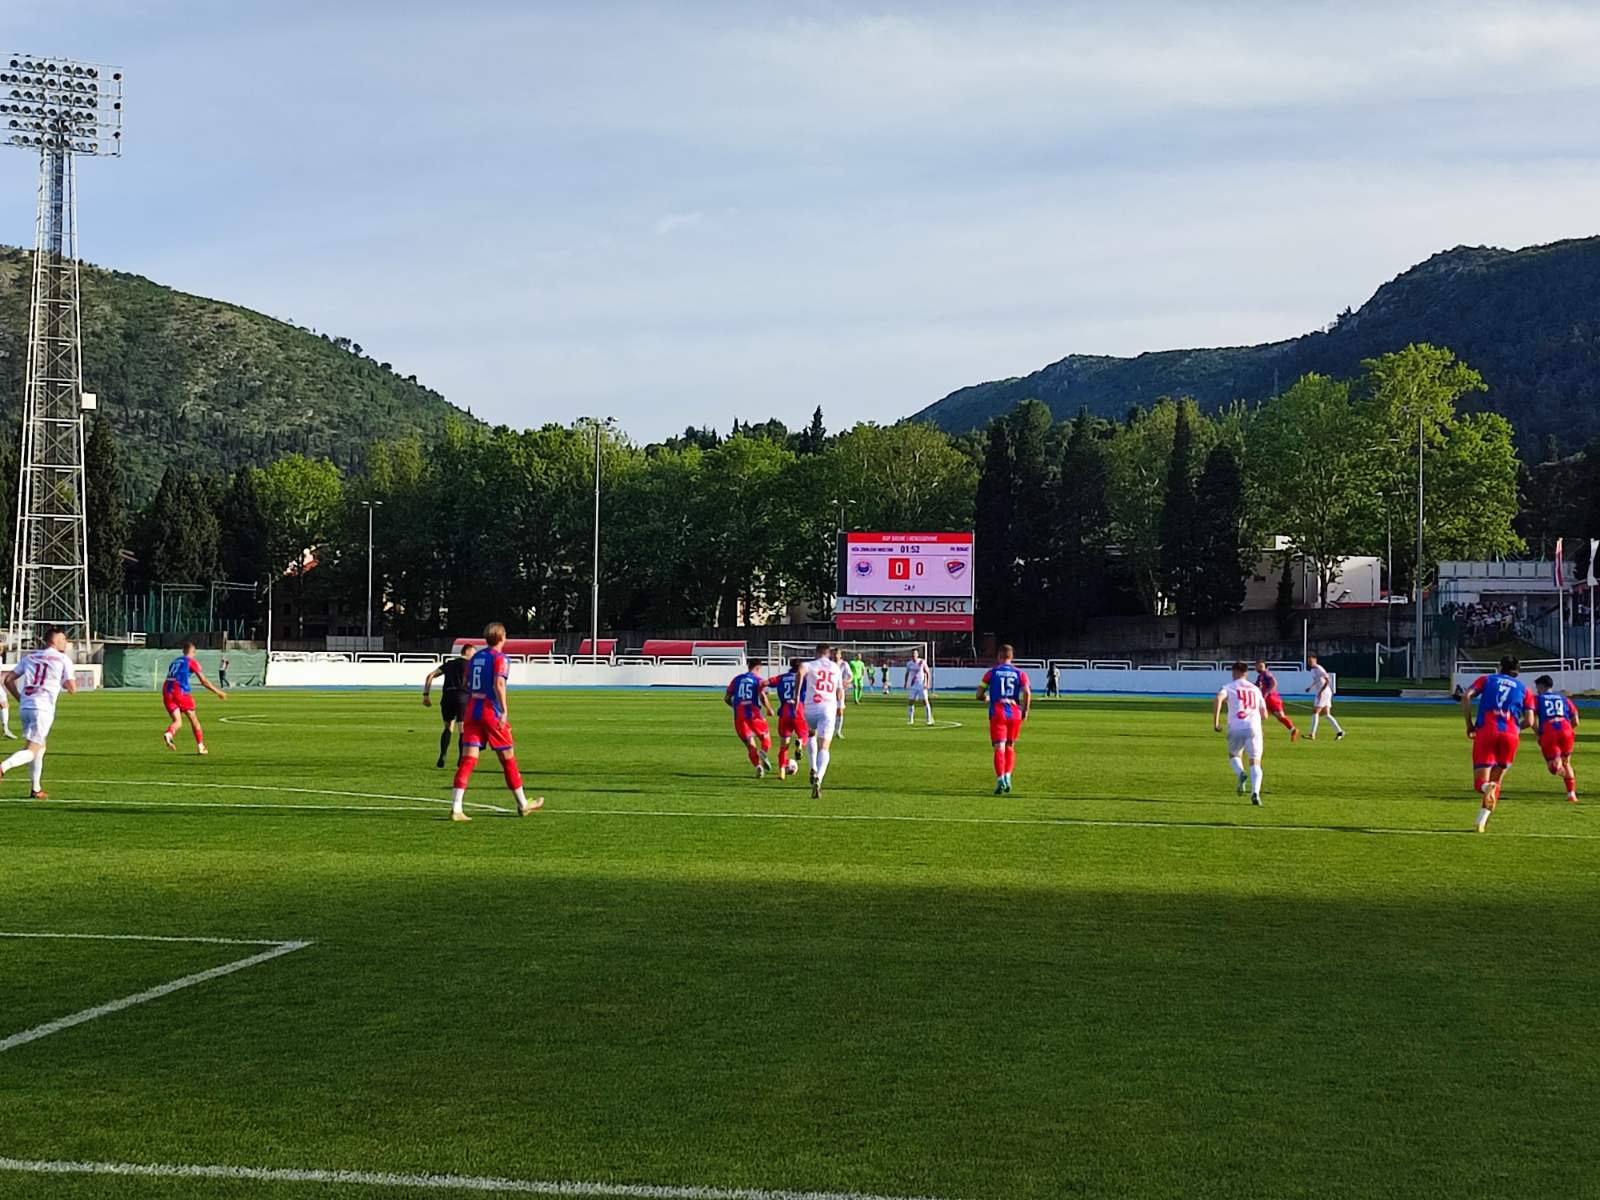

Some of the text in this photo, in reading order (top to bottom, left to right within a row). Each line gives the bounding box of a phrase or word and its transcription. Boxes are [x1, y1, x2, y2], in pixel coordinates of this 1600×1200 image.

[895, 562, 924, 576] 0 0
[883, 600, 966, 613] ZRINJSKI
[32, 663, 49, 686] 11
[472, 666, 482, 690] 6
[815, 670, 836, 693] 25
[738, 683, 754, 699] 45
[999, 677, 1016, 697] 15
[1497, 685, 1511, 709] 7
[1235, 689, 1257, 710] 40
